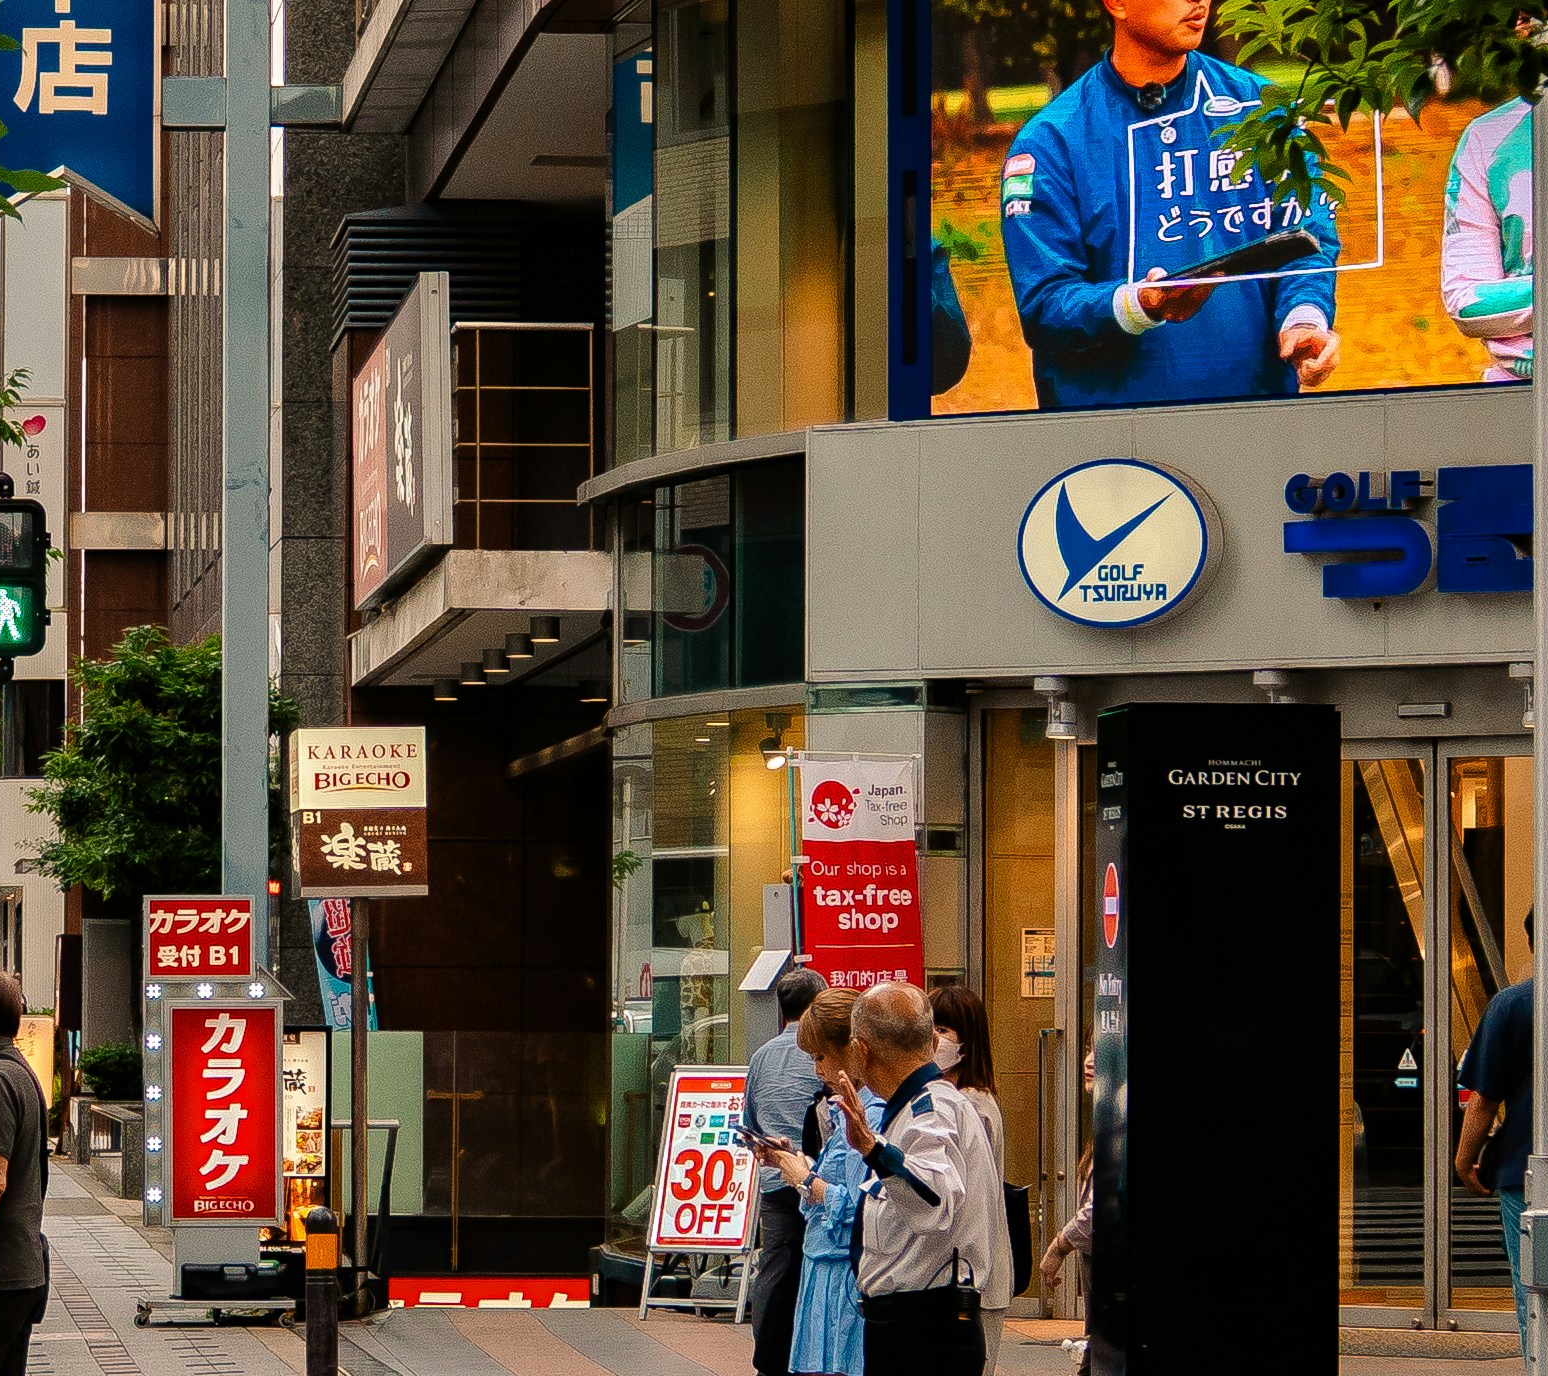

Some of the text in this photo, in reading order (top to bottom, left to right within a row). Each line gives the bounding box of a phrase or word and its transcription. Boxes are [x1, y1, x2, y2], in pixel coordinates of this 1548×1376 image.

[1283, 470, 1422, 514] GOLF
[1097, 564, 1143, 581] GOLF
[1079, 582, 1167, 603] TSURUYA
[307, 743, 418, 760] KARAOKE
[314, 771, 411, 791] BIG ECHO
[1168, 769, 1302, 786] GARDEN CITY
[865, 799, 909, 812] Tax-free
[1216, 804, 1288, 820] REGIS
[302, 811, 322, 824] B1
[880, 813, 909, 827] Shop
[810, 860, 908, 879] Our shop is a
[812, 883, 913, 907] tax-free
[149, 908, 252, 935] カラオケ
[837, 908, 900, 934] shop
[156, 945, 241, 968] 受付 B1
[199, 1012, 250, 1191] カラオケ
[193, 1199, 255, 1213] BIG ECHO
[674, 1203, 735, 1235] OFF
